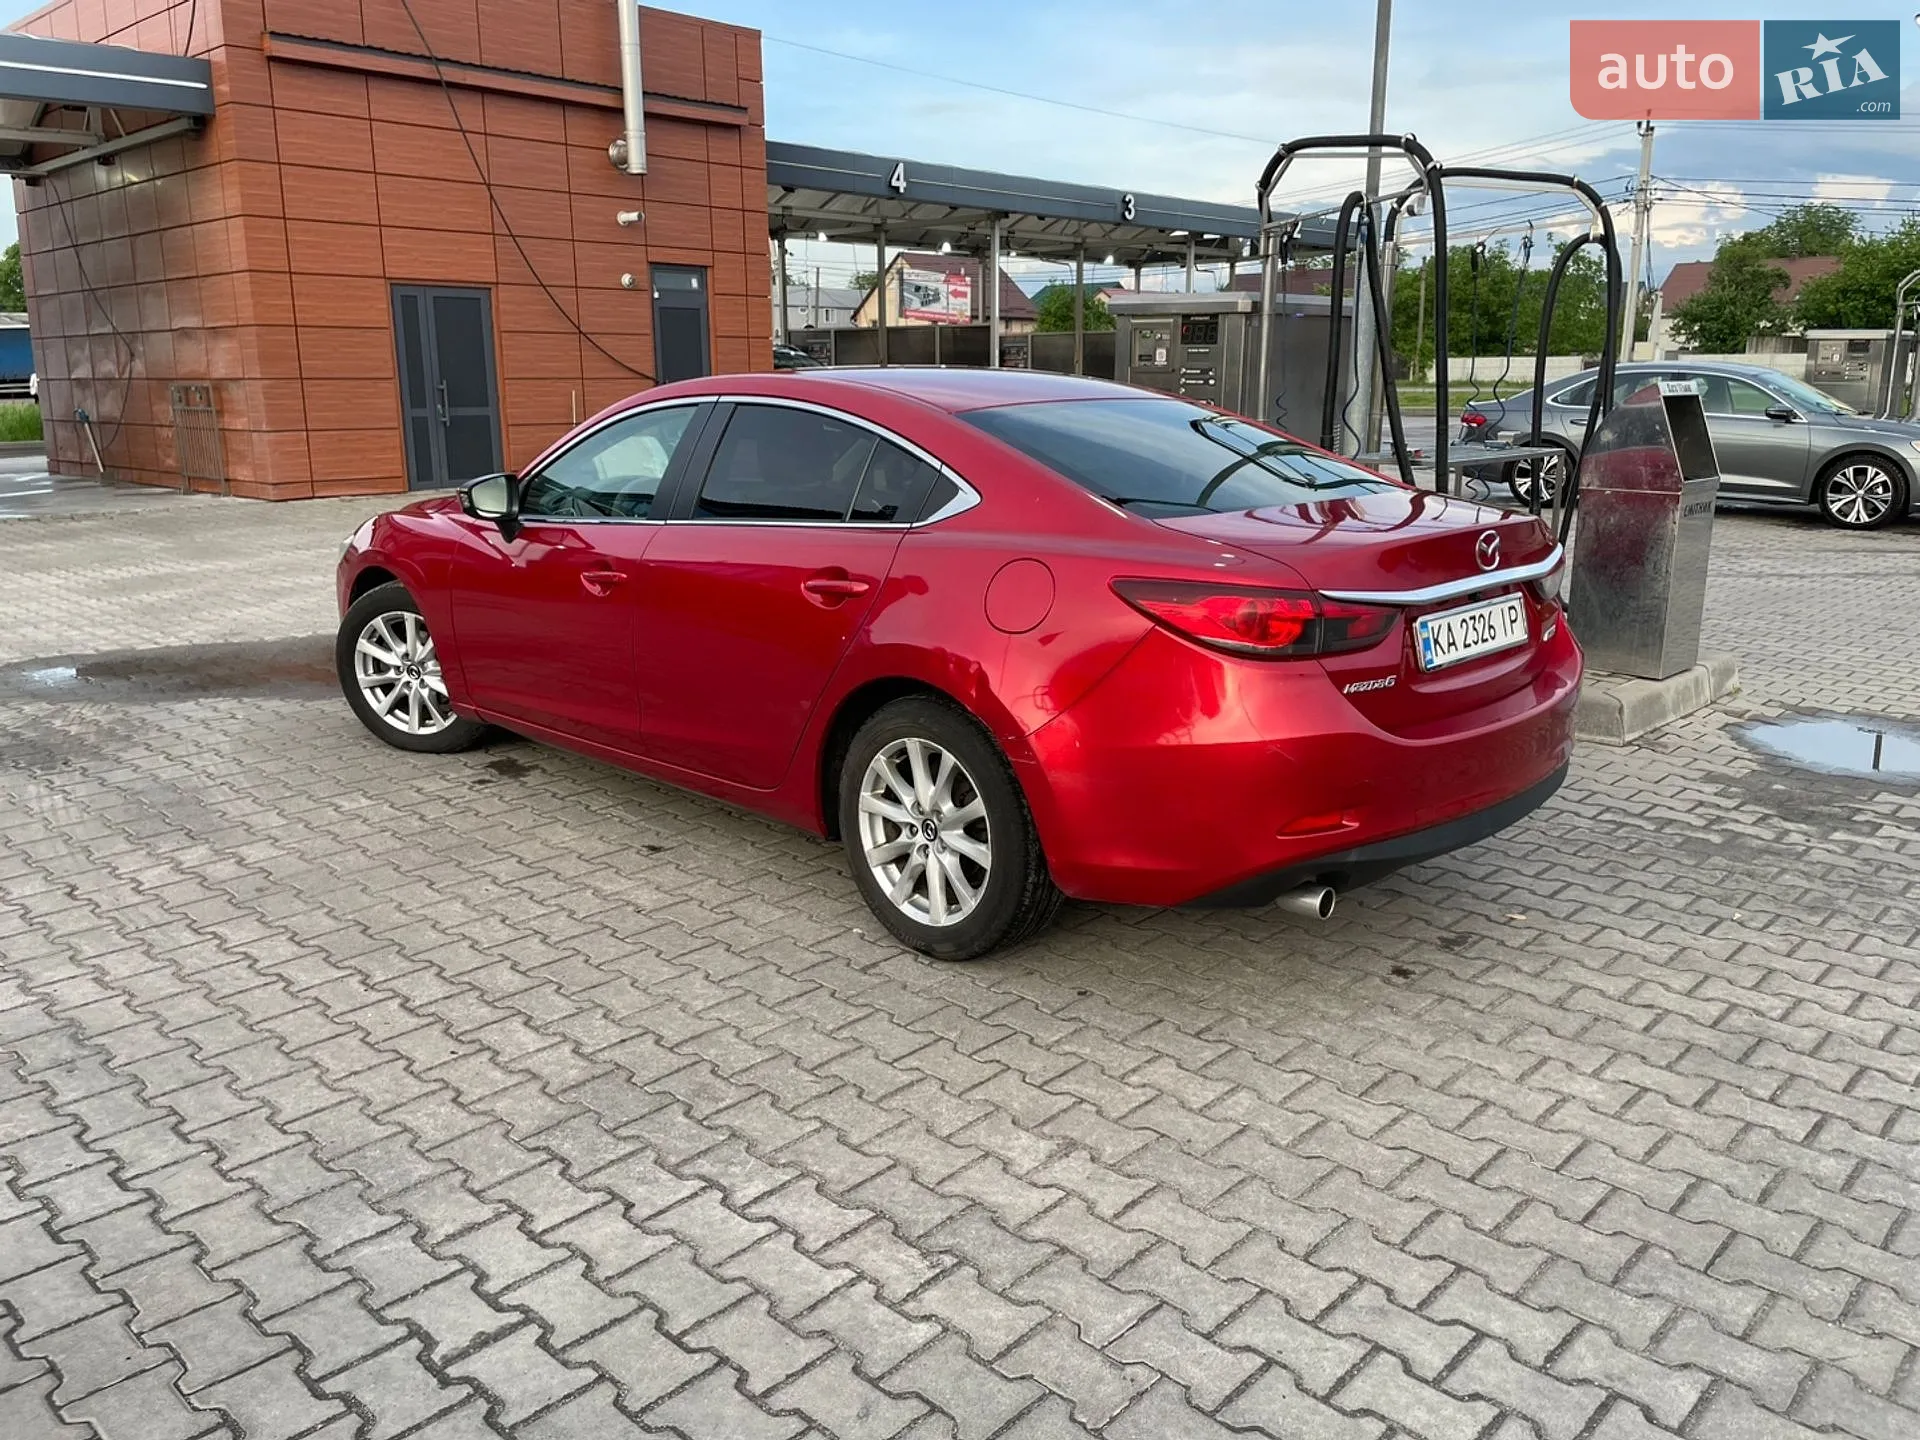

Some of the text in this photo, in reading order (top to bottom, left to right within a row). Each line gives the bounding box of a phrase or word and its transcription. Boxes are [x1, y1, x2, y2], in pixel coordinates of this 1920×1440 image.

[890, 162, 906, 193] 4
[1124, 194, 1135, 220] 3
[1431, 620, 1459, 657] KA
[1460, 610, 1496, 649] 2326
[1501, 605, 1519, 638] IP
